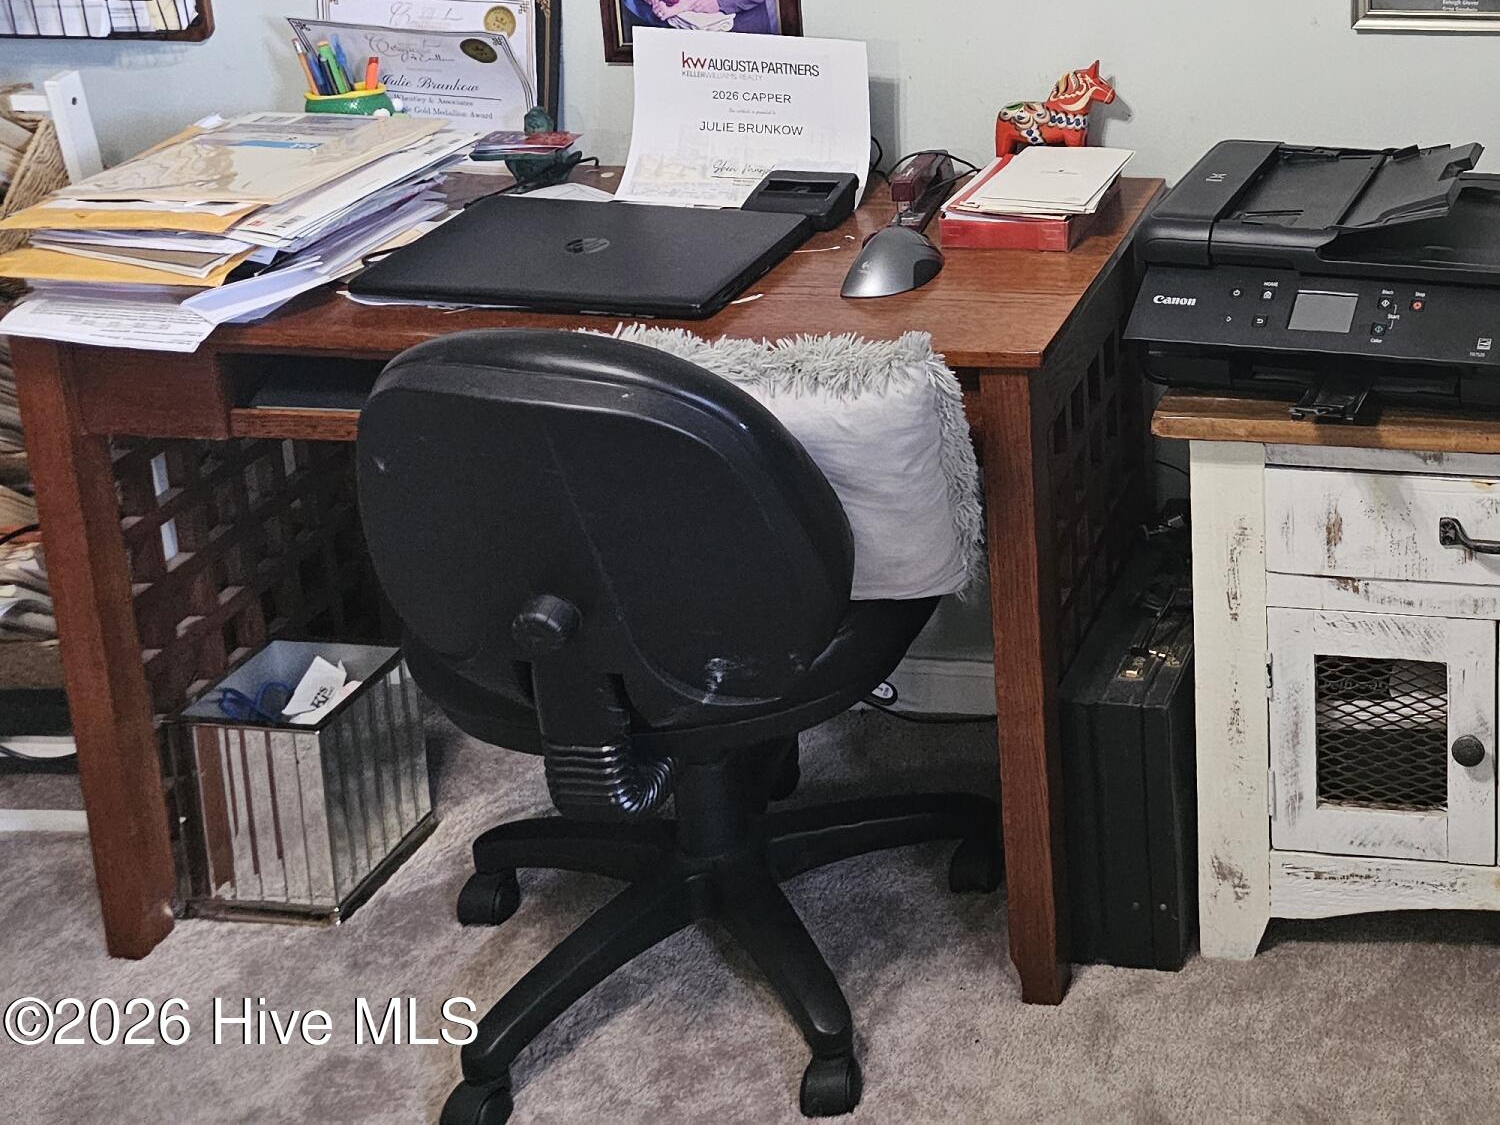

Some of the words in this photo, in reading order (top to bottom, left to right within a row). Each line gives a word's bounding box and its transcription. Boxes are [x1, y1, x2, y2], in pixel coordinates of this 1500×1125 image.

[682, 51, 706, 69] kw
[708, 58, 759, 73] AUGUSTA
[762, 61, 820, 77] PARTNERS
[382, 75, 410, 87] Julie
[417, 77, 479, 91] Brunkow
[712, 91, 739, 101] 2026
[742, 92, 792, 103] CAPPER
[471, 111, 493, 119] Award
[700, 121, 734, 133] JULIE
[738, 123, 803, 135] BRUNKOW
[1153, 295, 1196, 305] Canon
